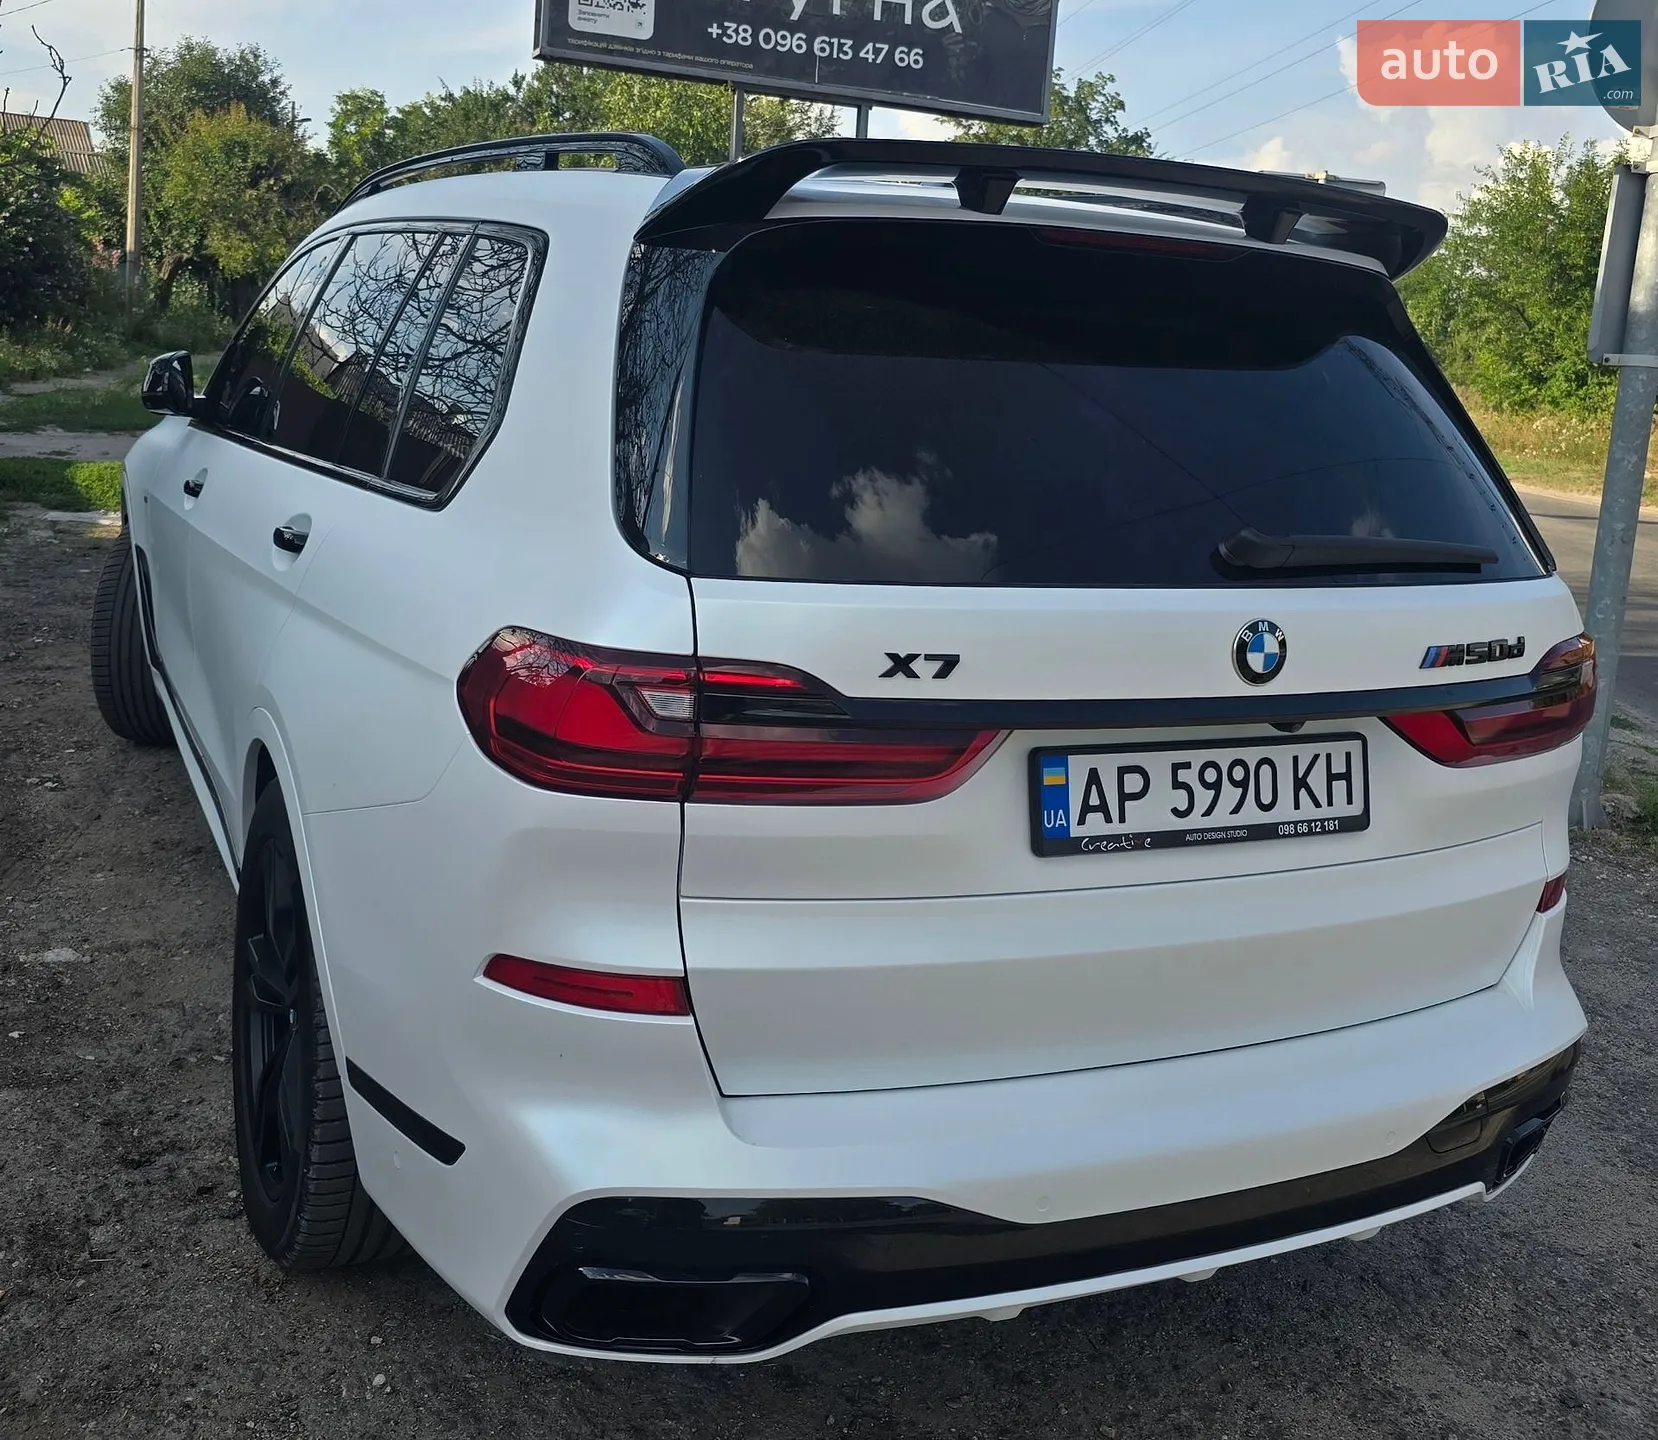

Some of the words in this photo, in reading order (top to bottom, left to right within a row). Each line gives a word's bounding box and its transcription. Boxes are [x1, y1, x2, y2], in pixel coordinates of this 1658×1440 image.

[707, 22, 753, 46] +38
[758, 28, 807, 54] 096
[813, 36, 853, 60] 613
[859, 42, 889, 64] 47
[894, 46, 924, 69] 66
[1240, 620, 1285, 642] BMW
[878, 652, 961, 679] X7
[1076, 765, 1151, 826] AP
[1170, 756, 1279, 819] 5990
[1291, 751, 1354, 811] KH
[1044, 809, 1068, 829] UA
[1185, 831, 1203, 842] AUTO
[1203, 830, 1227, 841] DESIGN
[1227, 829, 1248, 839] STUDIO
[1278, 824, 1295, 836] 098
[1297, 822, 1309, 834] 66
[1311, 821, 1322, 833] 12
[1324, 819, 1340, 832] 181
